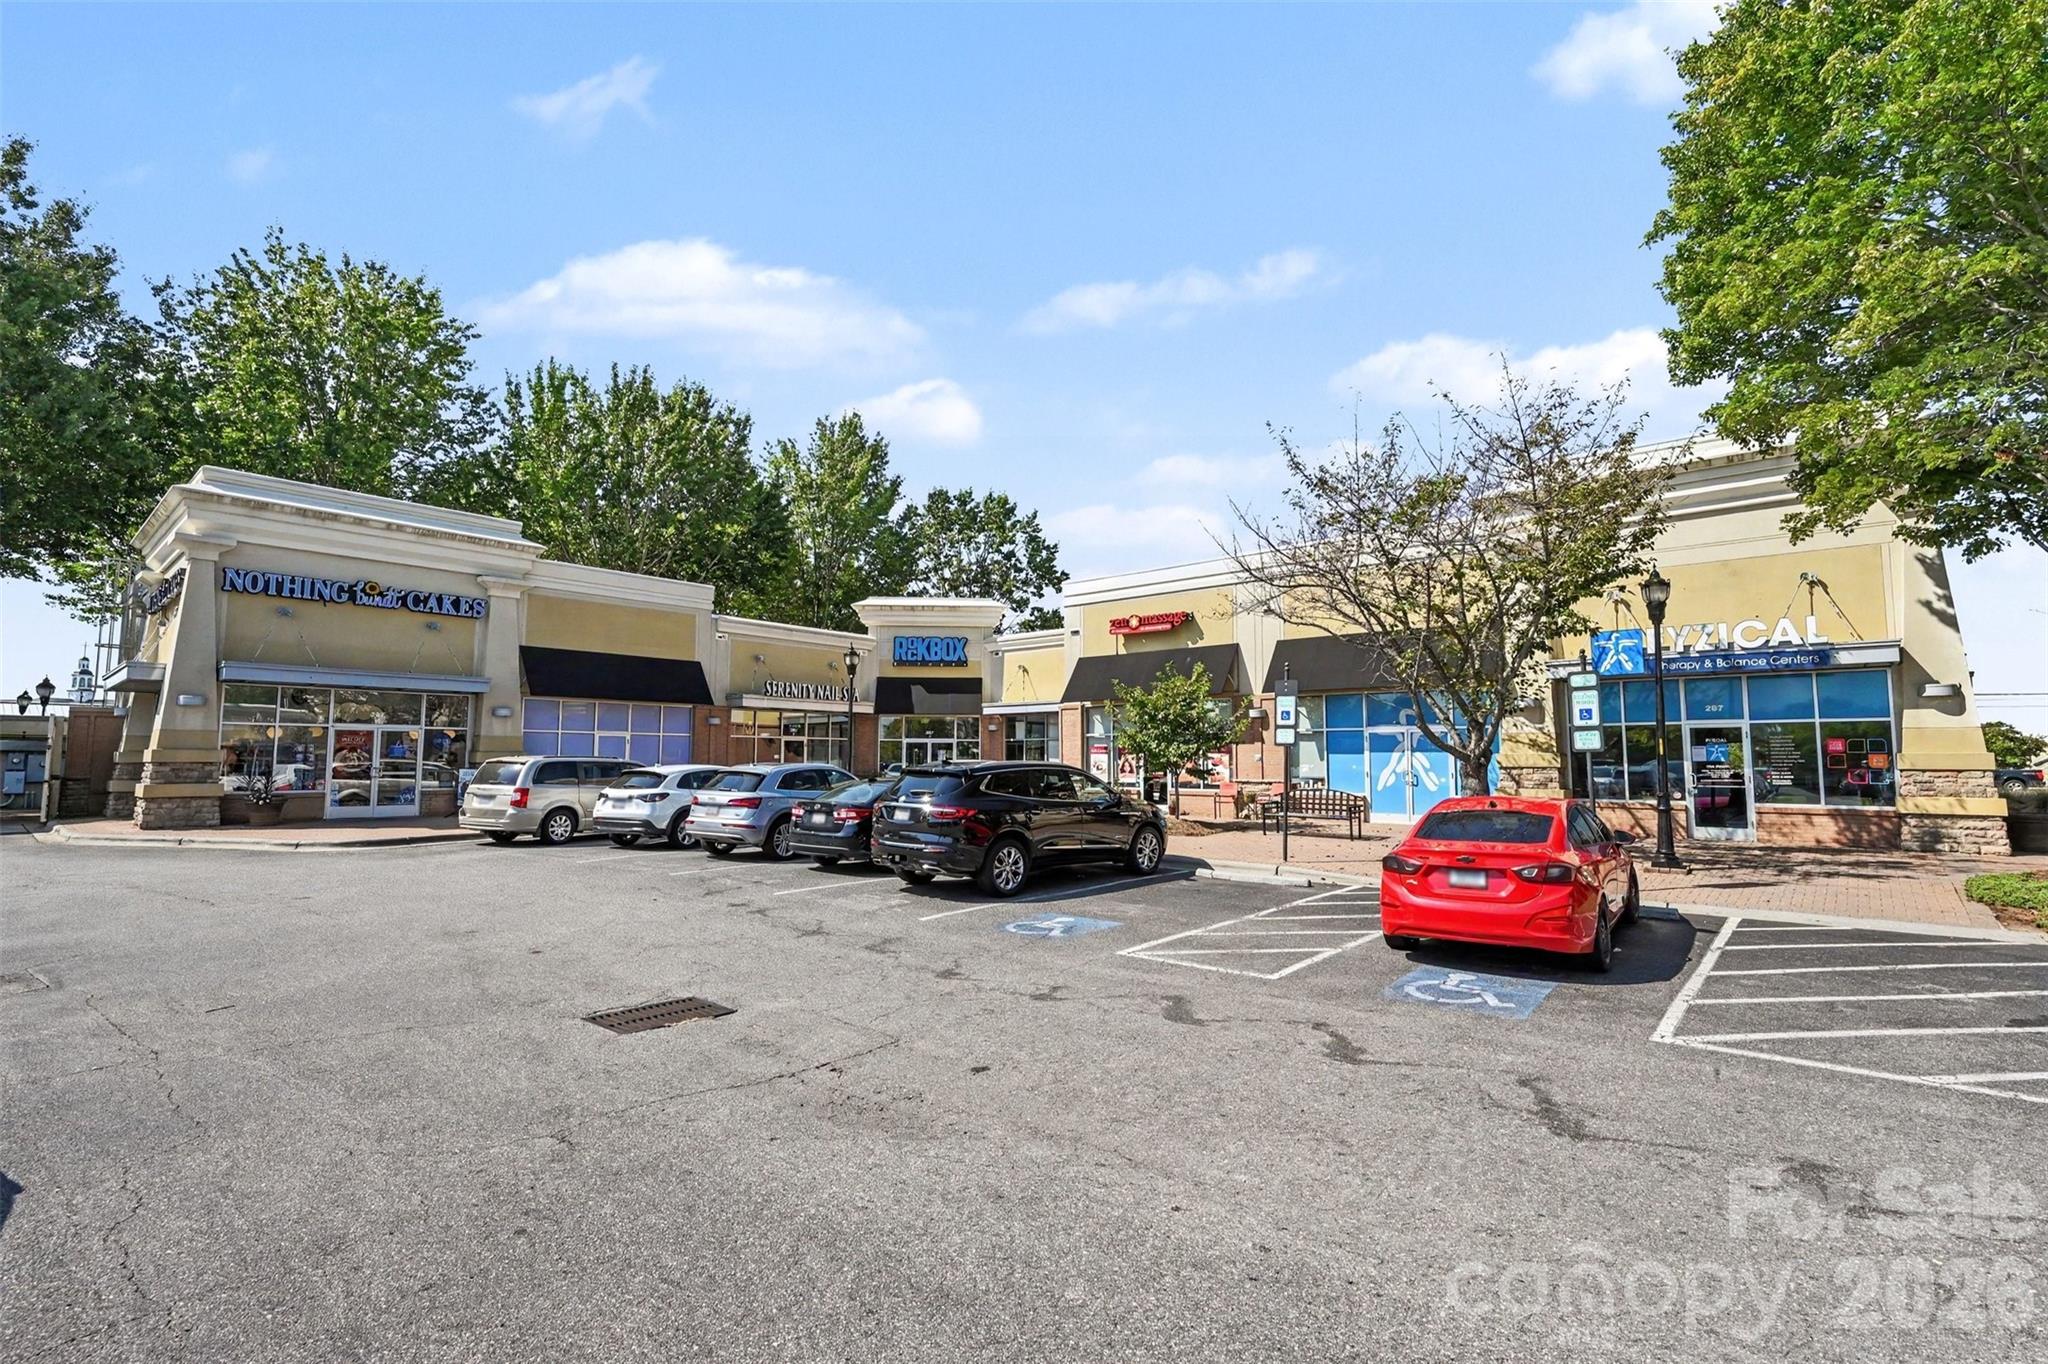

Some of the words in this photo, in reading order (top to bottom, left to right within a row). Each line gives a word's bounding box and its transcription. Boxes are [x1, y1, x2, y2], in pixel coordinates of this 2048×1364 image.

[223, 567, 349, 603] NOTHING
[353, 580, 404, 609] bundt
[406, 591, 487, 618] CAKES
[1140, 611, 1187, 626] massage
[893, 636, 968, 662] ROCKBOX
[1661, 659, 1701, 671] herapy
[1704, 659, 1713, 668] &
[1716, 656, 1767, 669] Balance
[1770, 654, 1820, 666] Centers
[766, 680, 814, 699] SERENITY
[816, 684, 840, 701] NAIL
[842, 686, 860, 702] SA
